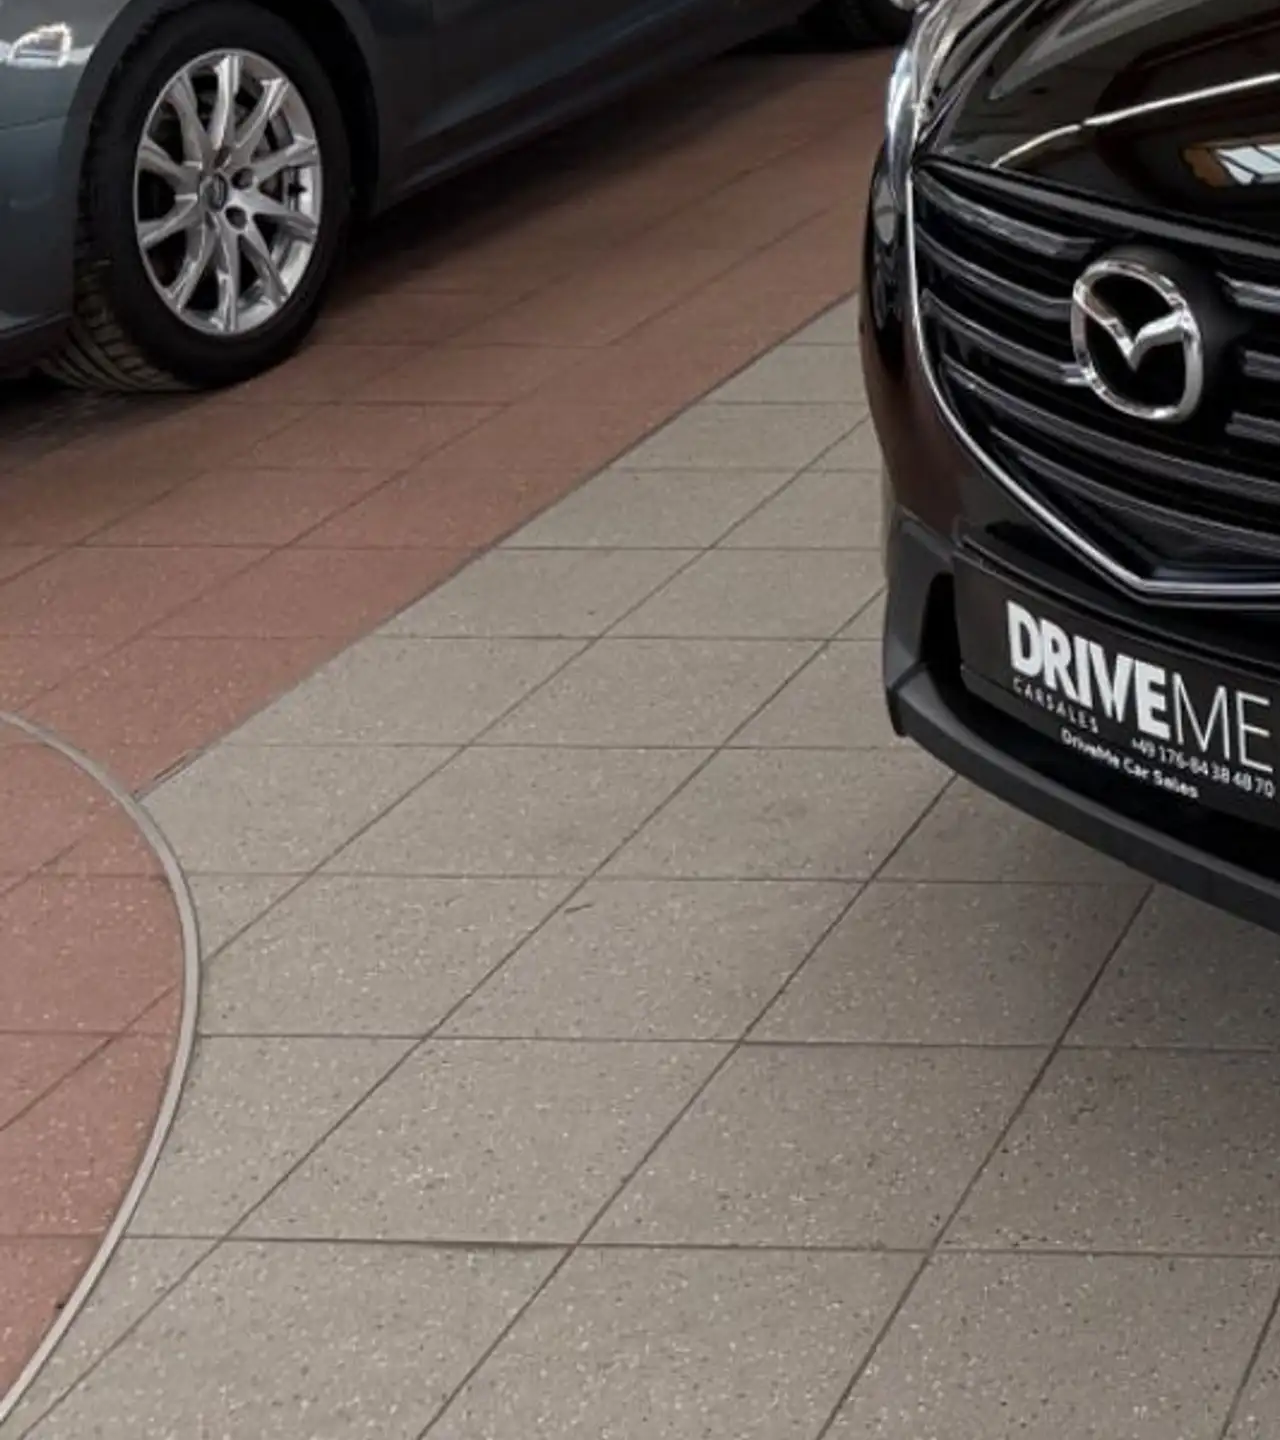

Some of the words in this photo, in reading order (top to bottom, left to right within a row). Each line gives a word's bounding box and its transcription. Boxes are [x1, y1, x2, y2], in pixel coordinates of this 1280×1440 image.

[1007, 599, 1274, 773] DRIVEME
[1012, 675, 1098, 734] CARSALES
[1123, 757, 1150, 781] Car
[1152, 769, 1199, 799] Sales
